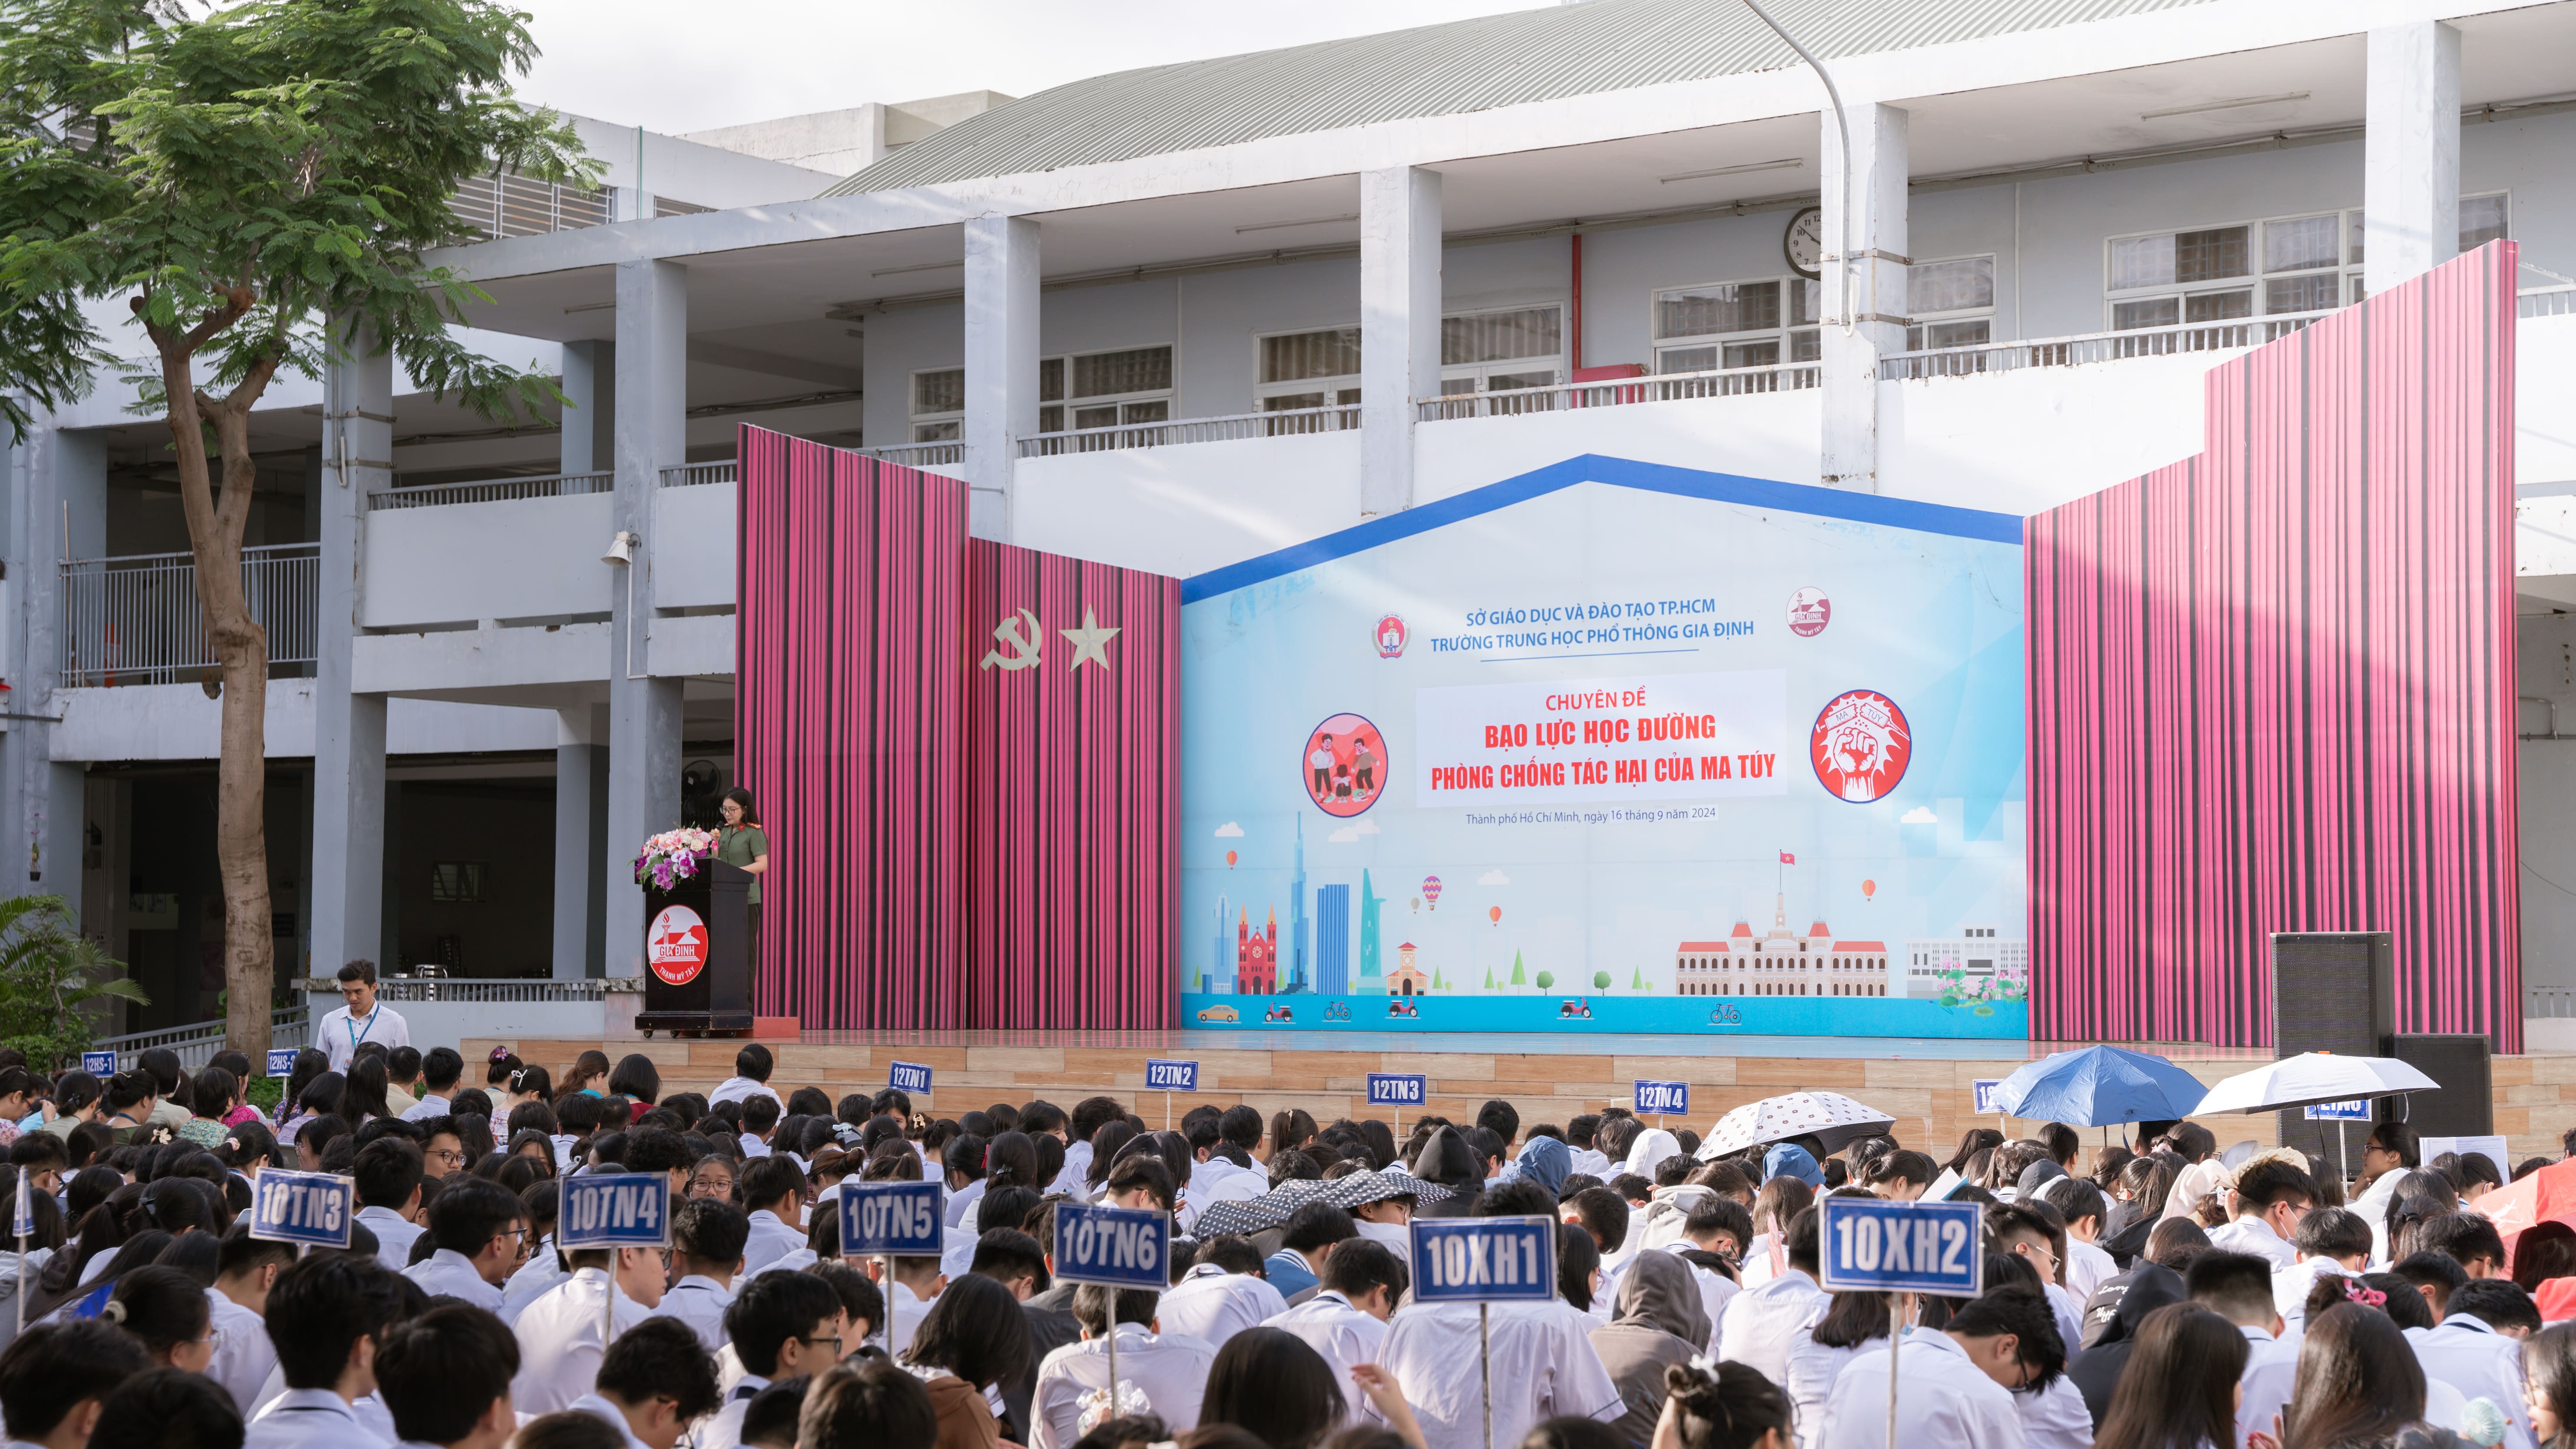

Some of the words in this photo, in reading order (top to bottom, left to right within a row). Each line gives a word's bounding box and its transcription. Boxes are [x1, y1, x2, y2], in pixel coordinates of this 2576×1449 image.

[1466, 608, 1486, 626] SỞ
[1489, 608, 1526, 625] GIÁO
[1530, 608, 1562, 625] DỤC
[1565, 603, 1584, 620] VÀ
[1588, 602, 1622, 619] ĐÀO
[1625, 602, 1655, 621] TẠO
[1659, 598, 1715, 615] TP.HCM
[1431, 634, 1492, 652] TRƯỜNG
[1496, 632, 1547, 648] TRUNG
[1551, 630, 1583, 648] HỌC
[1588, 623, 1619, 643] PHỔ
[1623, 624, 1678, 641] THÔNG
[1682, 623, 1709, 638] GIA
[1713, 621, 1754, 640] ĐỊNH
[1546, 689, 1617, 711] CHUYÊN
[1622, 685, 1646, 707] ĐỀ
[1836, 711, 1848, 721] MA
[1868, 708, 1883, 722] TÚY
[1485, 724, 1528, 752] BẠO
[1536, 719, 1576, 750] LỰC
[1584, 718, 1629, 748] HỌC
[1637, 712, 1715, 741] ĐƯỜNG
[1432, 763, 1493, 790] PHÒNG
[1500, 755, 1565, 788] CHỐNG
[1571, 758, 1608, 785] TÁC
[1615, 759, 1647, 788] HẠI
[1654, 752, 1694, 782] CỦA
[1701, 755, 1732, 780] MA
[1738, 750, 1775, 778] TÚY
[1466, 813, 1496, 824] Thành
[1499, 812, 1517, 826] phố
[1520, 811, 1533, 823] Hồ
[1536, 812, 1552, 823] Chí
[1554, 811, 1581, 823] Minh,
[1584, 811, 1608, 824] ngày
[1611, 810, 1622, 820] 16
[1625, 810, 1654, 822] tháng
[1657, 811, 1663, 820] 9
[1666, 809, 1688, 819] năm
[1692, 808, 1716, 818] 2024
[660, 946, 673, 956] GIA
[86, 1057, 112, 1072] 12HS-1
[894, 1067, 925, 1088] 12TN1
[1151, 1065, 1192, 1085] 12TN2
[1373, 1080, 1419, 1100] 12TN3
[1639, 1087, 1683, 1108] 12TN4
[261, 1182, 343, 1231] 10TN3
[570, 1186, 658, 1231] 10TN4
[848, 1196, 933, 1239] 10TN5
[1063, 1218, 1157, 1271] 10TN6
[1836, 1216, 1967, 1274] 10XH2
[1426, 1234, 1538, 1286] 10XH1
